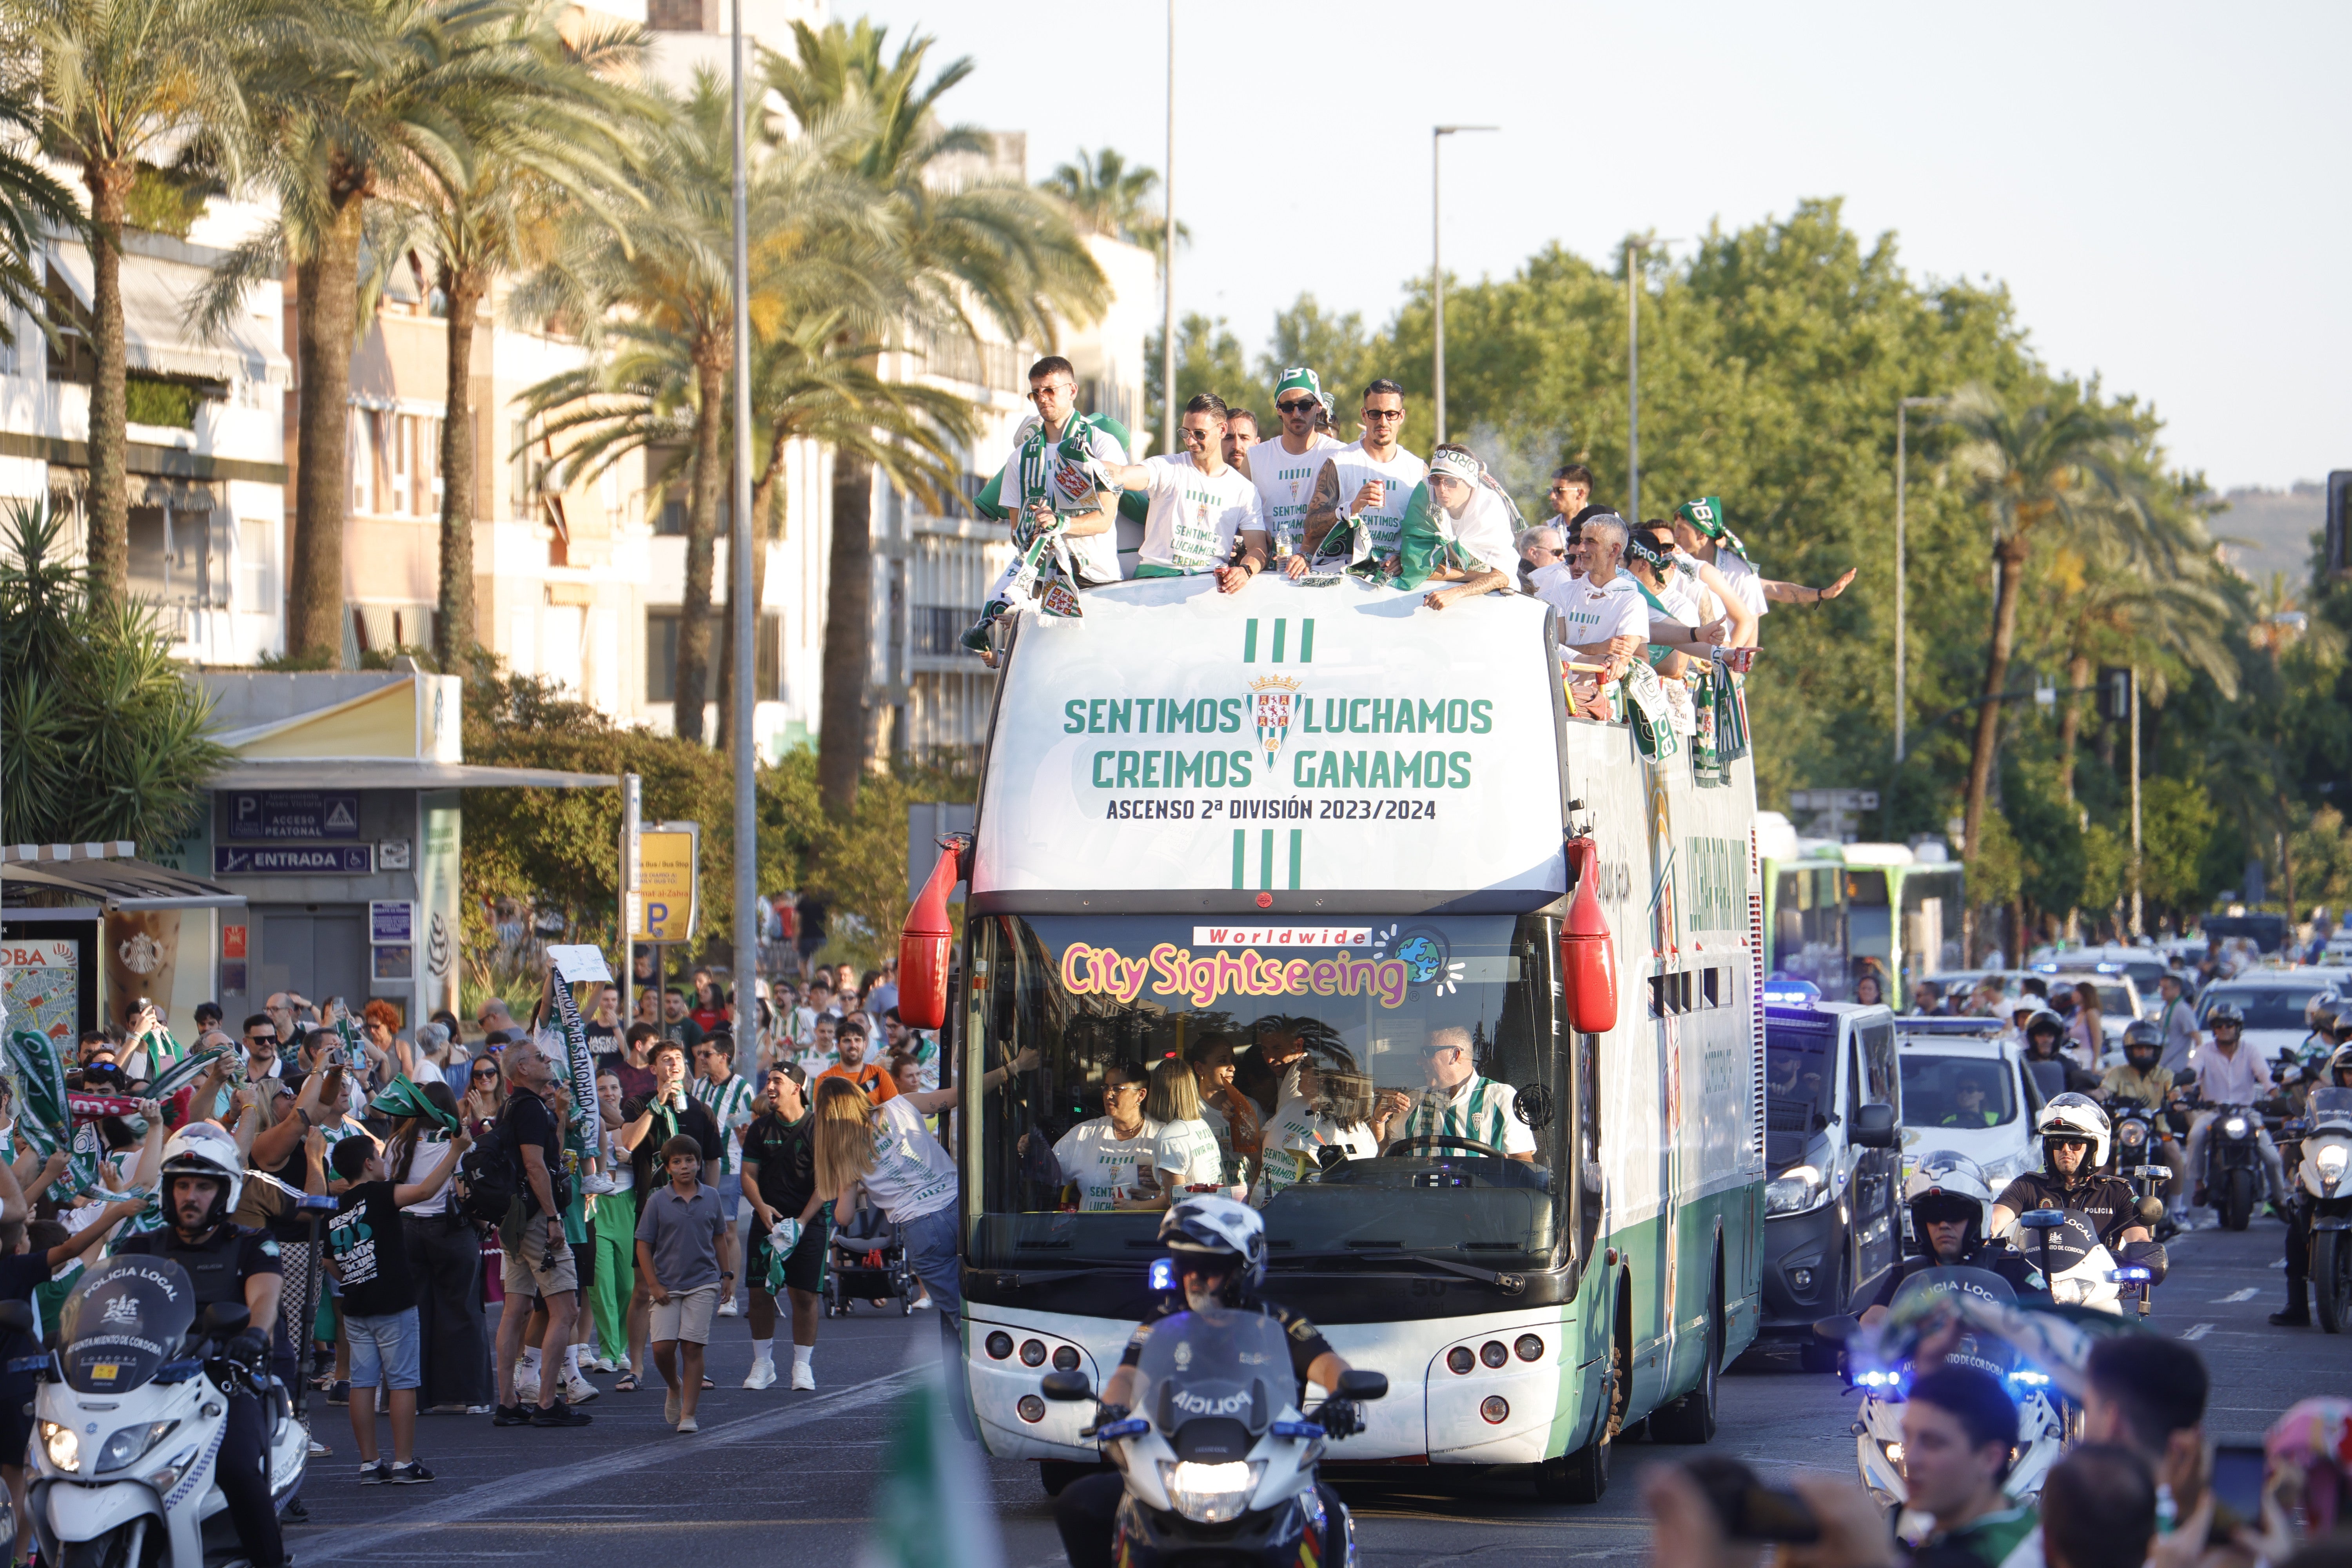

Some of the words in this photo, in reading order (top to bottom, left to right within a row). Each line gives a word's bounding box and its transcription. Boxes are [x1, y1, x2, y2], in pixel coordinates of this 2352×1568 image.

[1273, 504, 1308, 517] SENTIMO
[1175, 524, 1217, 543] SENTIMOS
[1170, 538, 1216, 556] LUCHAMOS
[1172, 554, 1210, 566] CREIMOS
[1063, 698, 1242, 733] SENTIMOS
[1303, 698, 1493, 734] LUCHAMOS
[1093, 750, 1252, 788] CREIMOS
[1294, 750, 1472, 789] GANAMOS
[238, 797, 257, 820] P
[1106, 800, 1194, 819] ASCENSO
[1201, 800, 1223, 819] 2ª
[1230, 795, 1312, 819] DIVISIÓN
[1320, 800, 1436, 819] 2023/2024
[272, 815, 315, 825] ACCESO
[265, 826, 323, 837] PEATONAL
[254, 852, 337, 867] ENTRADA
[648, 903, 668, 934] P
[1209, 929, 1366, 944] Worldwide
[1061, 942, 1149, 1003] City
[1150, 943, 1408, 1009] Sightseeing
[1263, 1147, 1296, 1167] SENTIMOS
[1090, 1186, 1112, 1197] SENT
[2063, 1216, 2092, 1242] LOCAL
[2024, 1245, 2058, 1254] AYUNTANTO
[2065, 1245, 2086, 1256] CORDOBA
[83, 1266, 137, 1299] POLICIA
[140, 1267, 178, 1302] LOCAL
[1963, 1281, 2000, 1307] LOCA
[1960, 1354, 1969, 1364] DE
[1970, 1356, 2004, 1378] CORDOBA
